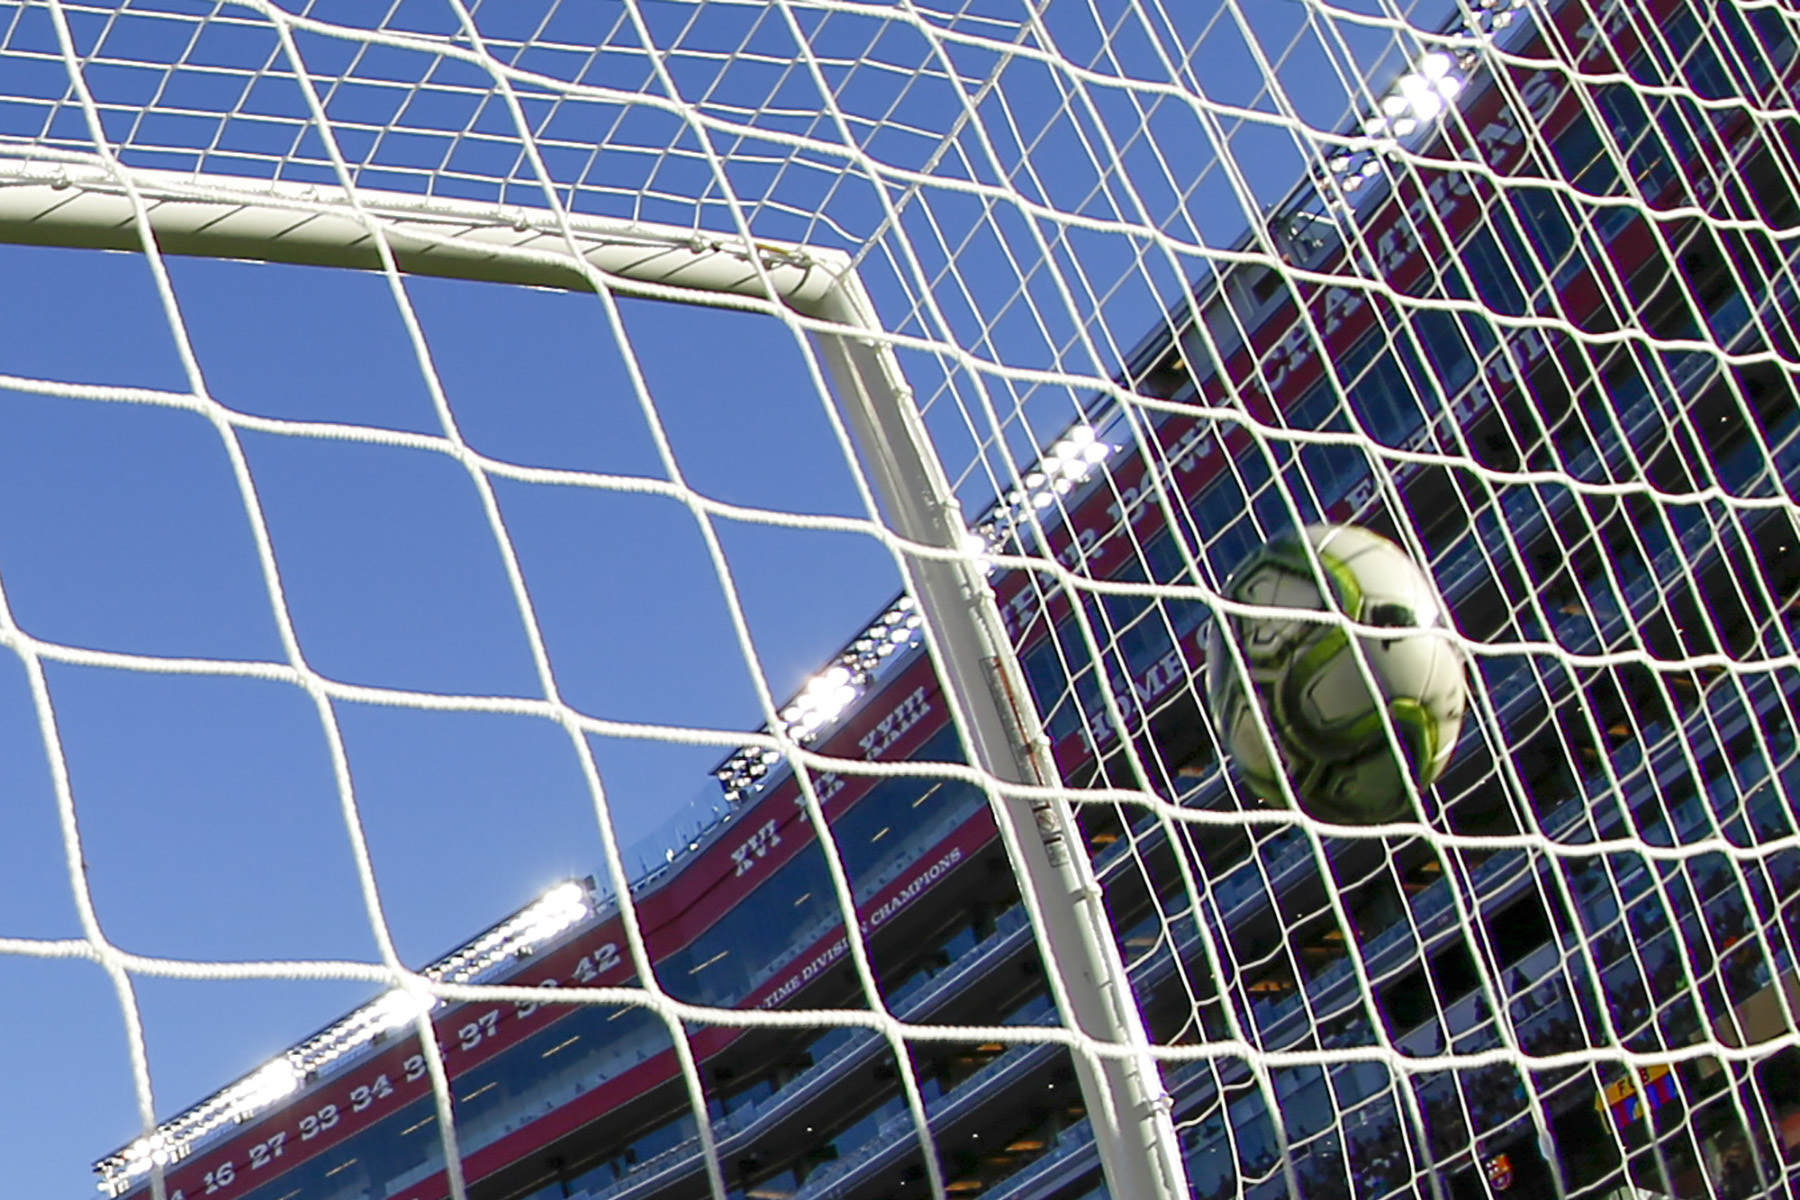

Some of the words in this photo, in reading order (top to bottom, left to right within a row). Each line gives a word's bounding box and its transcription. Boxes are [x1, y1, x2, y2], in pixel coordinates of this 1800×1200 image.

[1077, 650, 1185, 753] HOME
[802, 922, 869, 980] DIVISIN
[870, 847, 962, 926] CHAMPIONS
[203, 1161, 236, 1195] 16
[249, 1131, 286, 1169] 27
[299, 1104, 340, 1141] 33
[350, 1073, 394, 1112] 34
[458, 1009, 499, 1051] 37
[571, 943, 621, 983] 42
